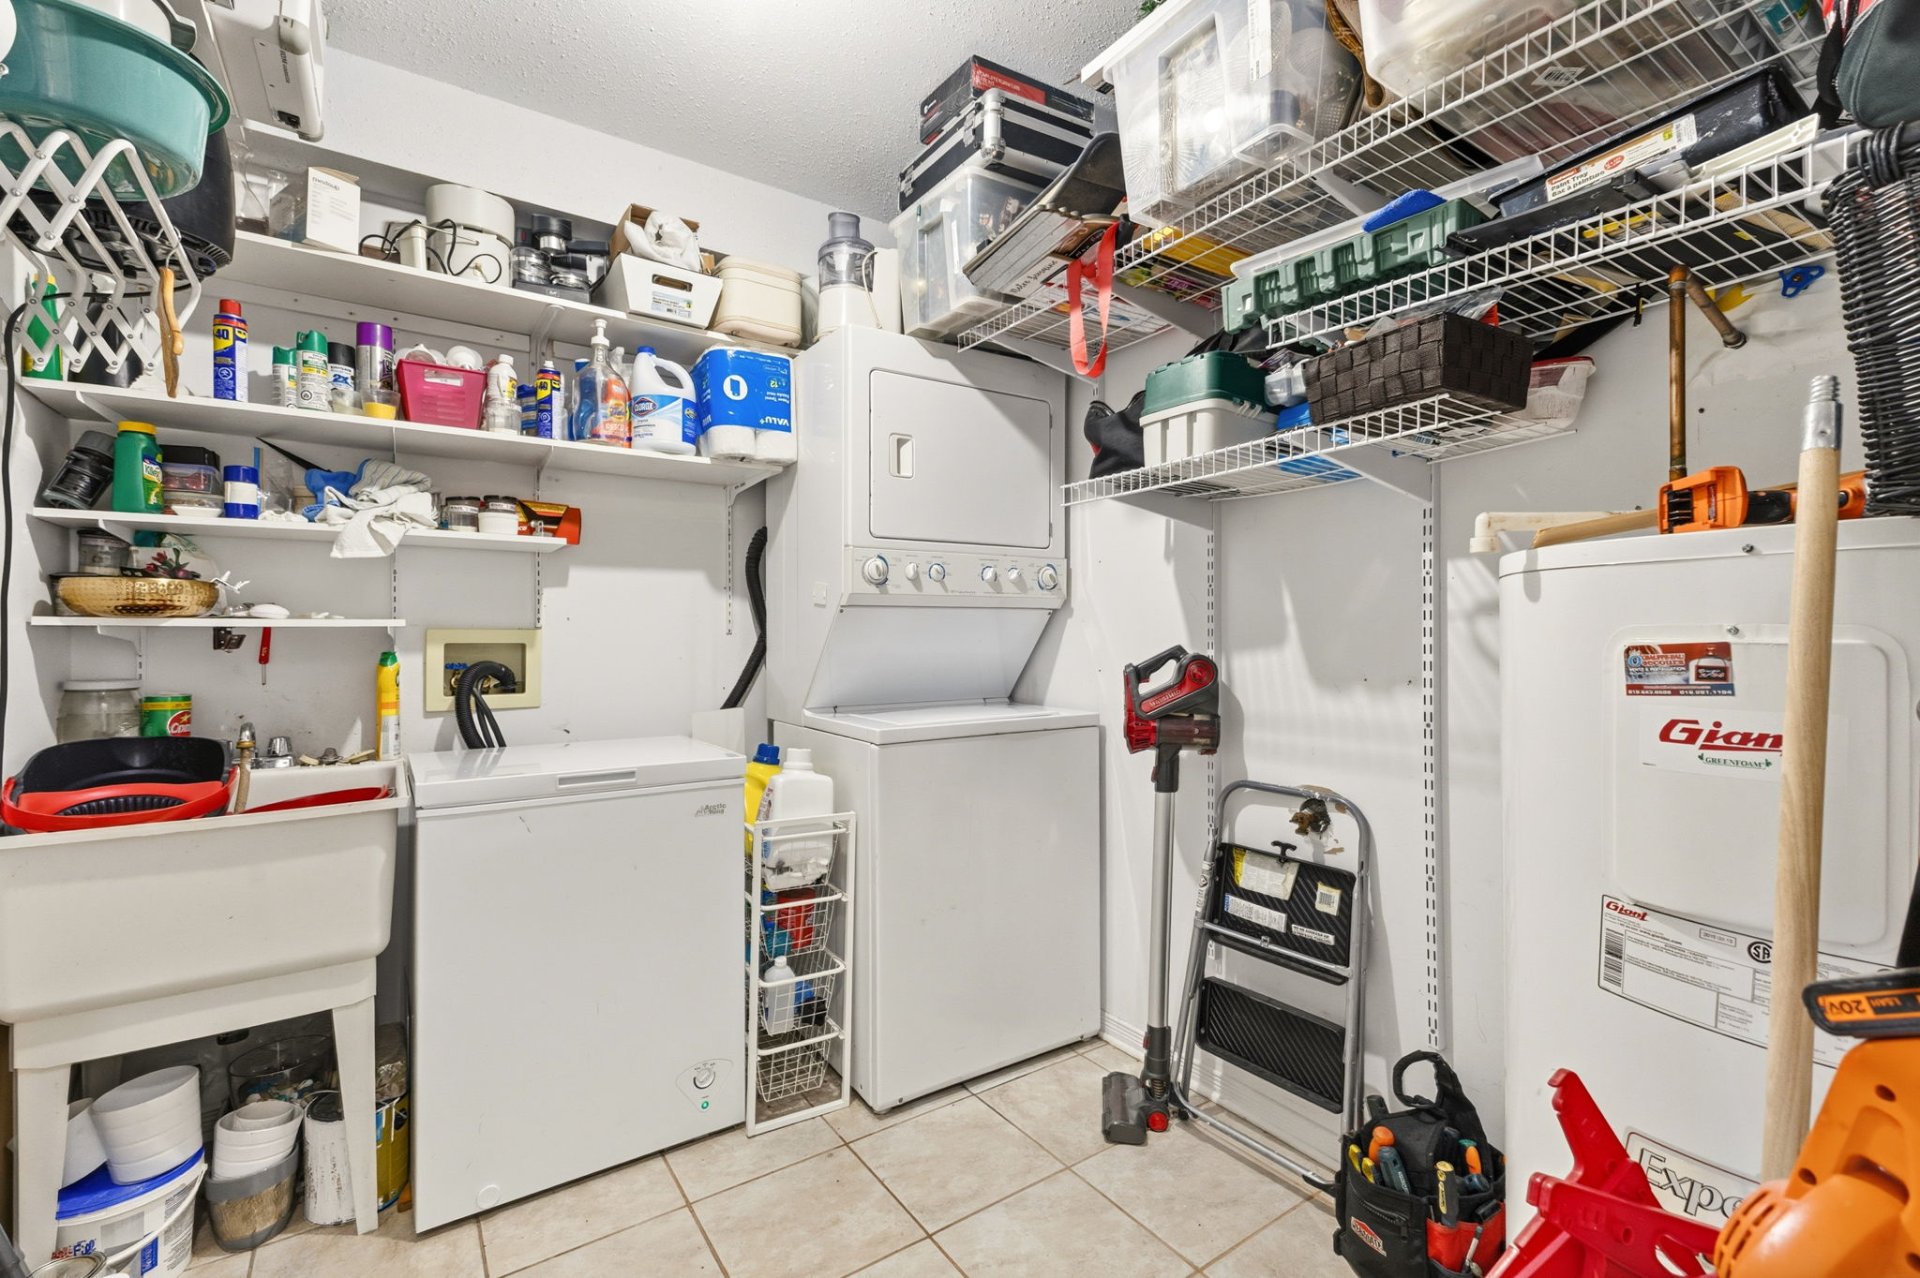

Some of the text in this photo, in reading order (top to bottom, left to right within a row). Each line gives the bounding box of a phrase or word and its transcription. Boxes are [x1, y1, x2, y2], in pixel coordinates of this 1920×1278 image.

[1659, 719, 1783, 750] Gian
[1603, 900, 1648, 921] Giant
[1828, 1000, 1866, 1014] 20V
